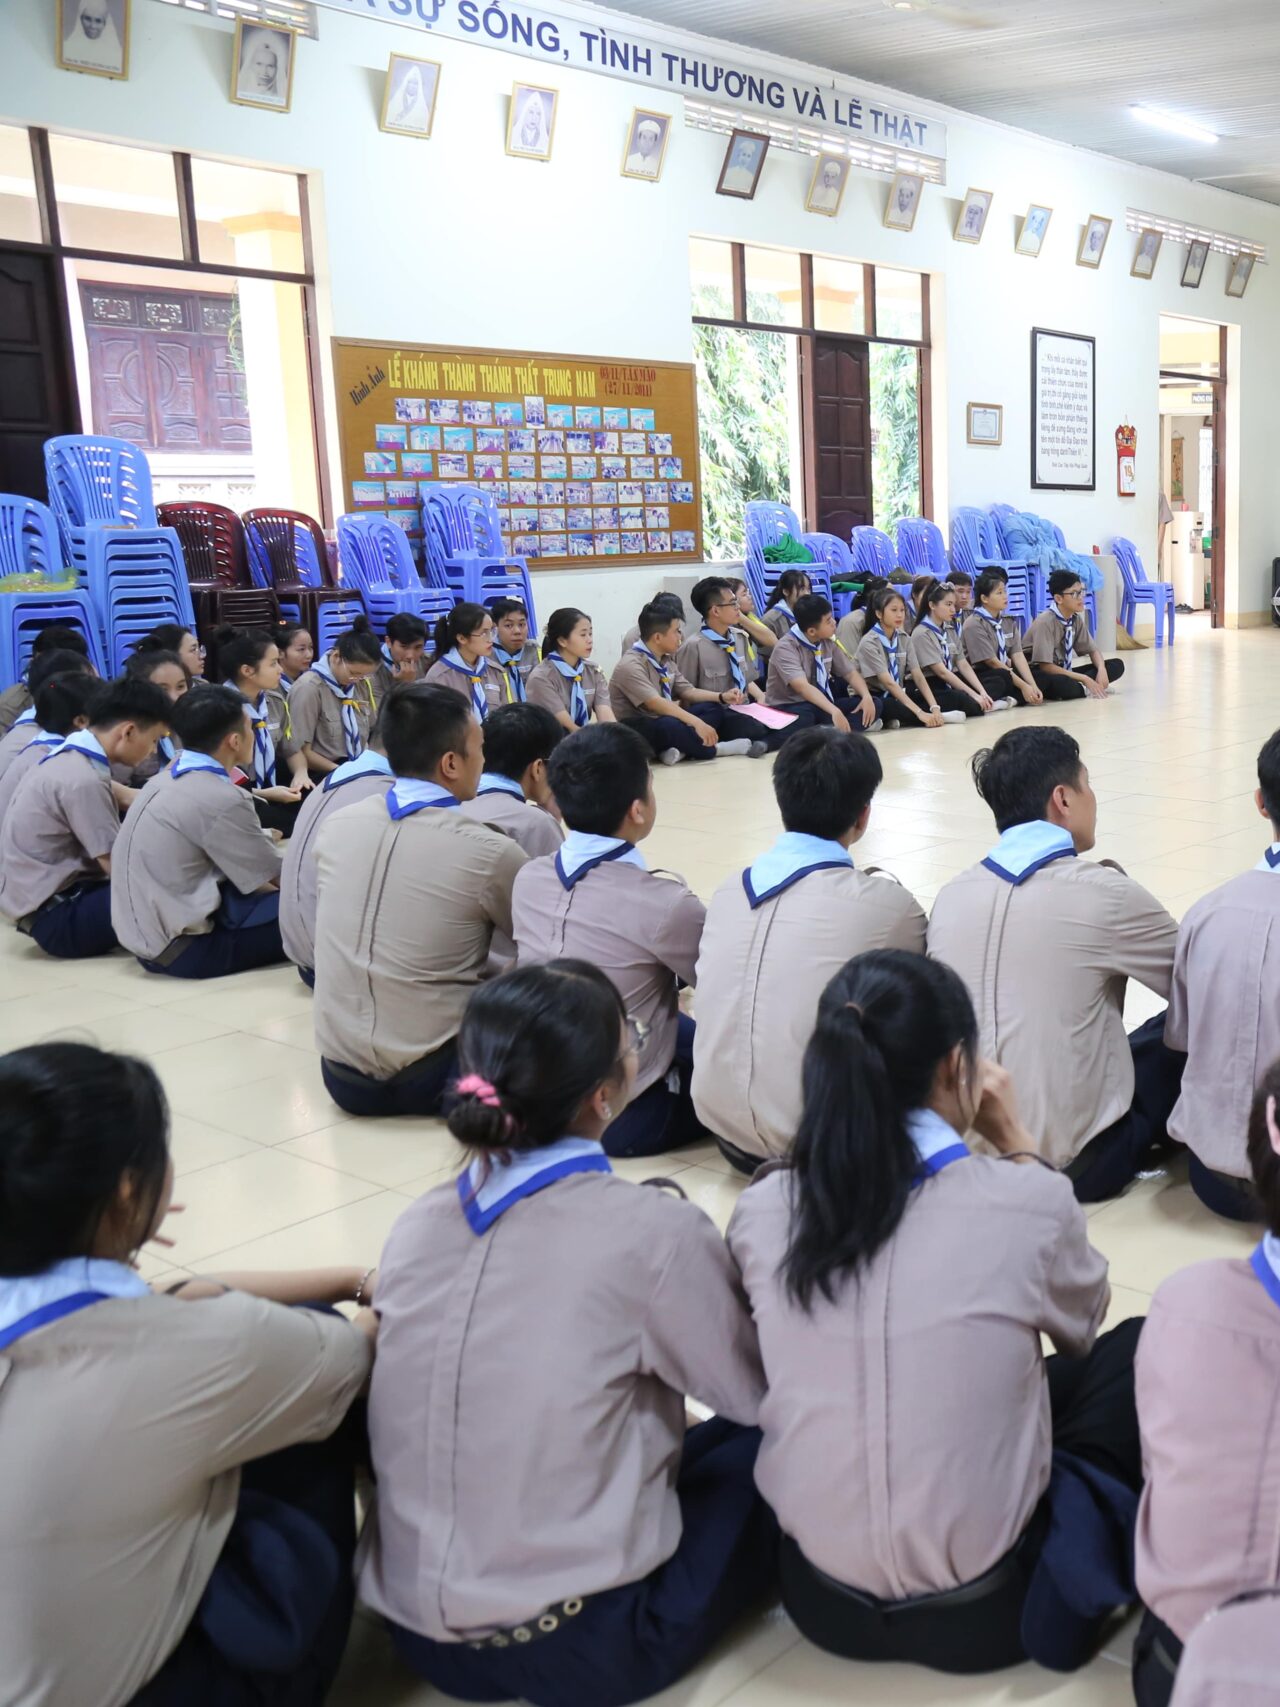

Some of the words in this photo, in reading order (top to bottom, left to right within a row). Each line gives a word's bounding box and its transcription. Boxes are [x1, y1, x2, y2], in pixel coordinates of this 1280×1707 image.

[457, 0, 569, 61] SỐNG,
[579, 28, 652, 76] TÌNH
[661, 52, 785, 109] THƯƠNG
[792, 87, 827, 120] VÀ
[834, 98, 863, 130] LẼ
[869, 108, 928, 148] THẬT
[388, 352, 401, 389] LỄ
[403, 353, 439, 390] KHÁNH
[442, 354, 476, 392] THÀNH
[480, 357, 513, 394] THÁNH
[515, 359, 539, 395] THẤT
[543, 367, 573, 397] TRUNG
[576, 370, 596, 398] NAM
